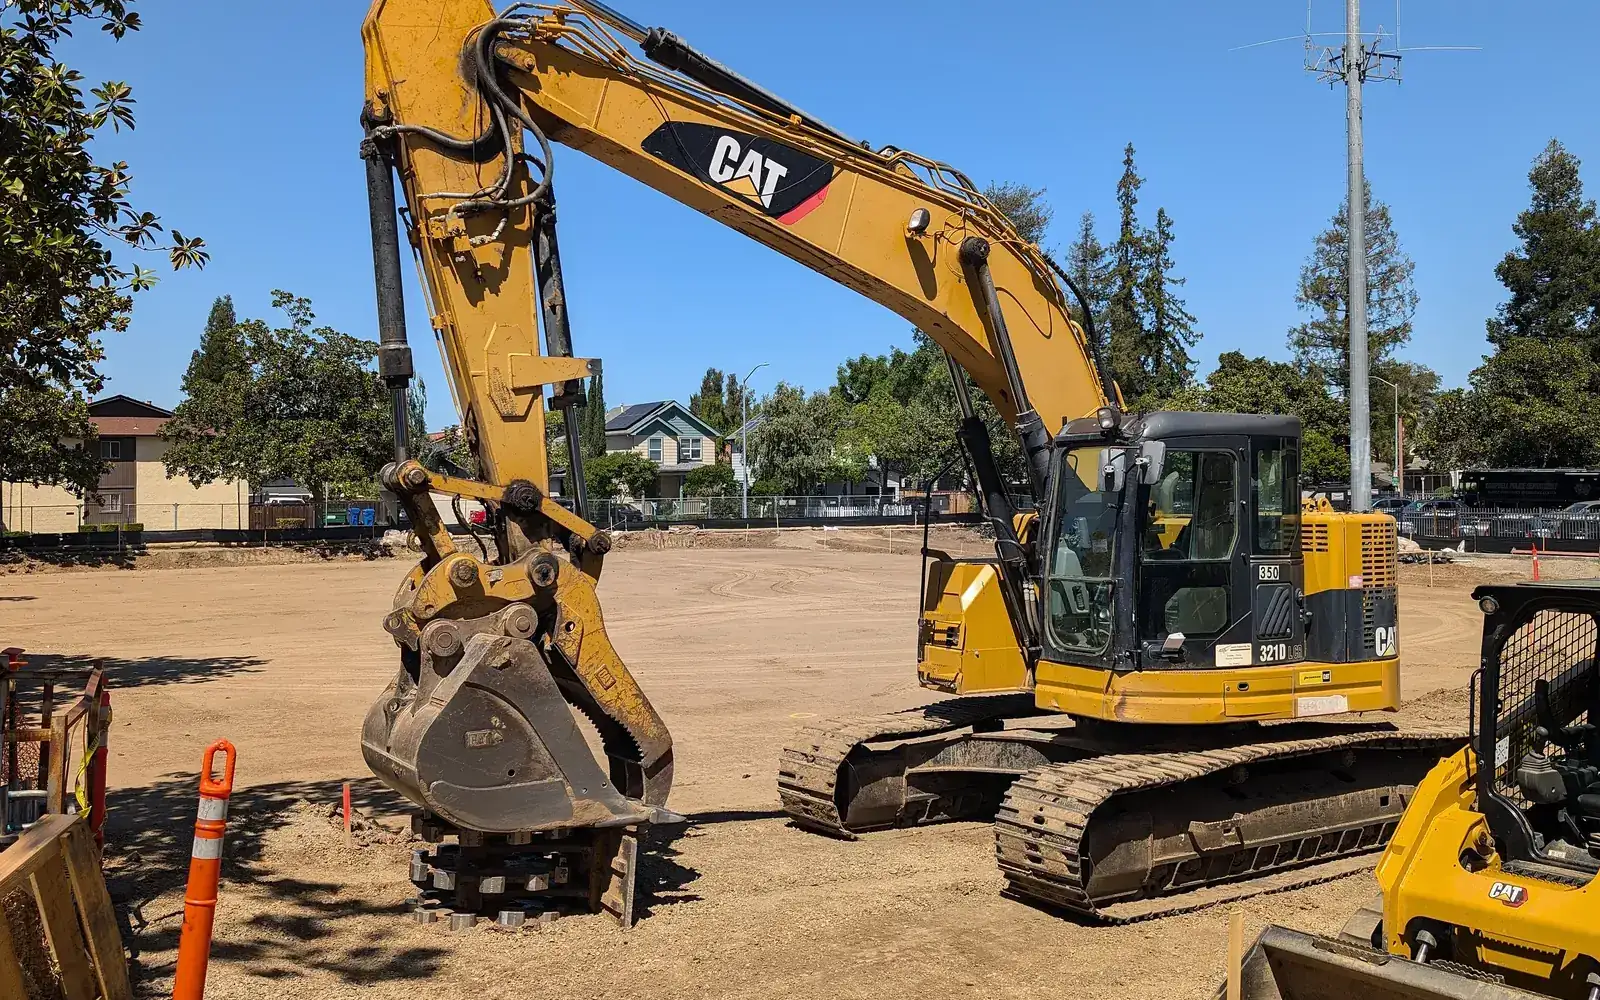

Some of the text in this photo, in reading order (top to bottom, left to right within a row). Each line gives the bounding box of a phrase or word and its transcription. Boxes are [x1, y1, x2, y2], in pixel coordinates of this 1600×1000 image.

[708, 135, 788, 208] CAT
[1260, 566, 1279, 579] 350
[1259, 643, 1286, 662] 321D
[1489, 881, 1523, 903] CAT
